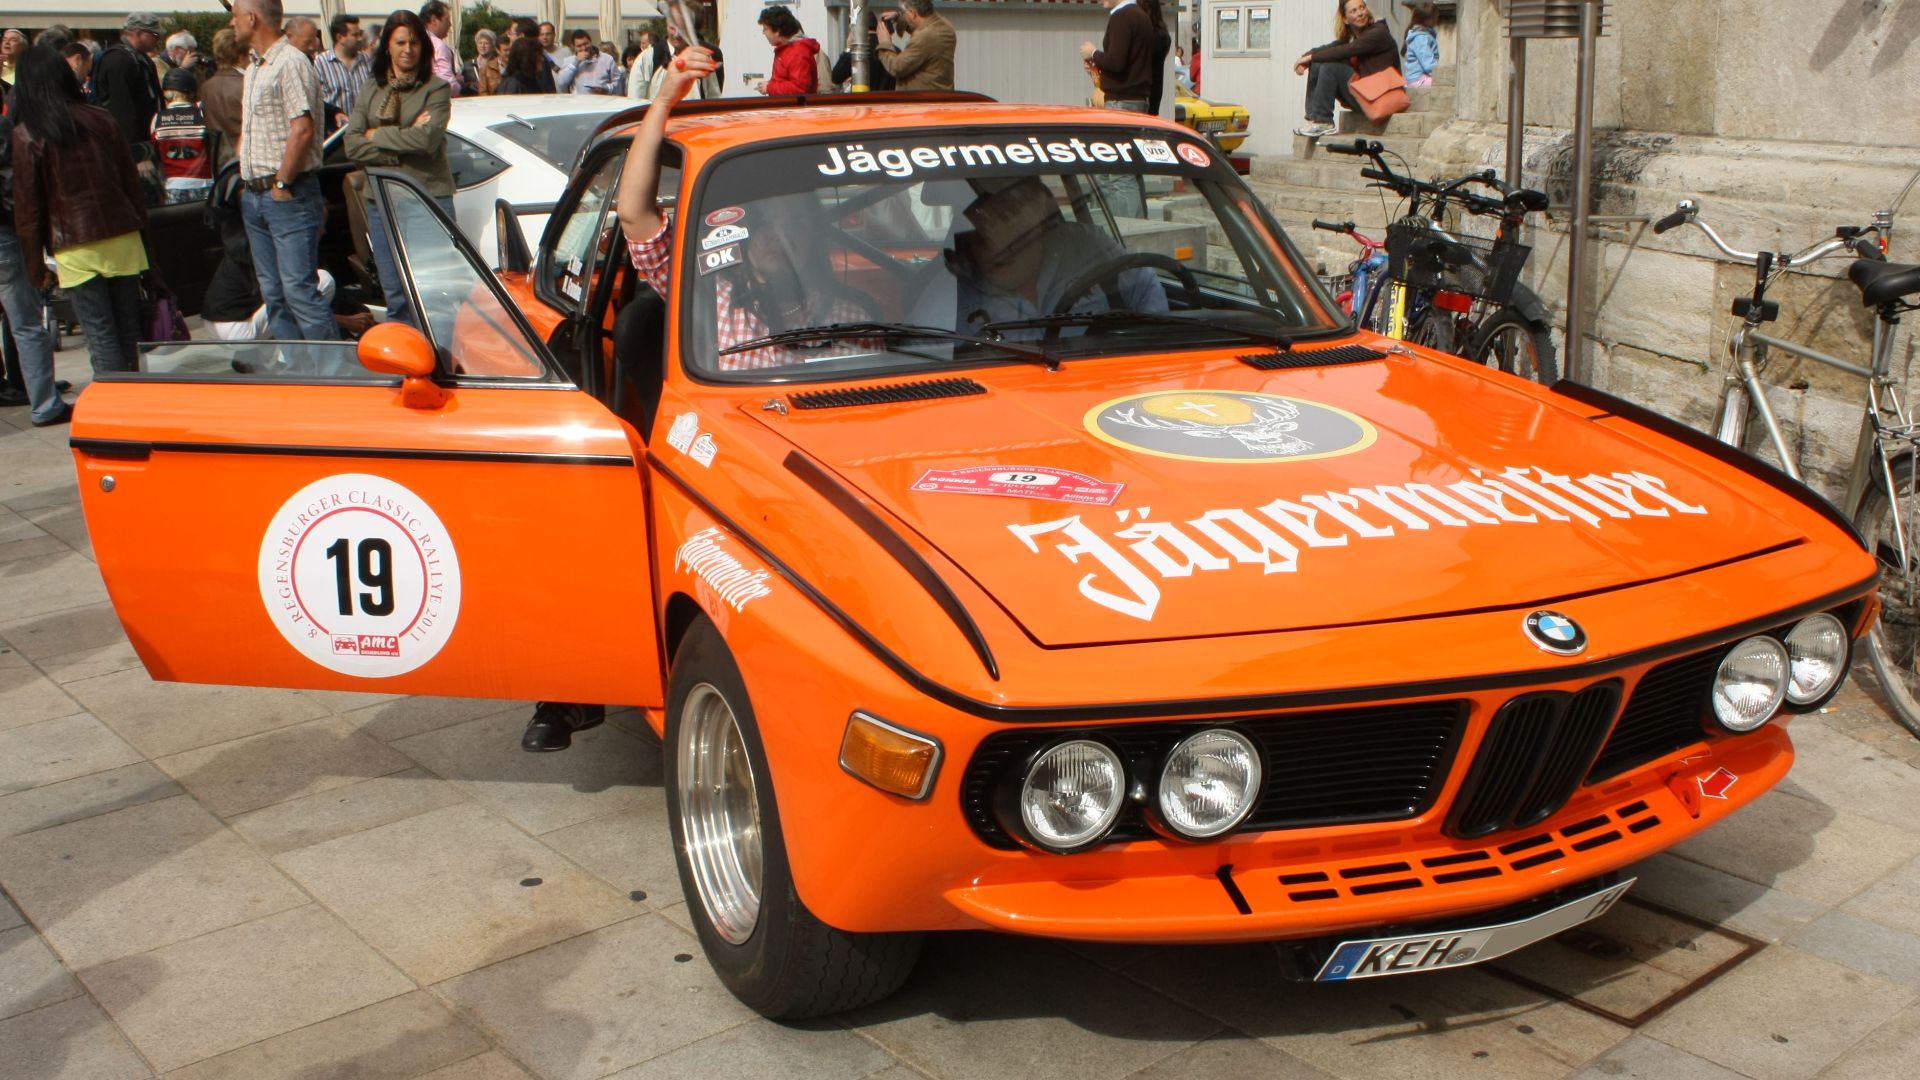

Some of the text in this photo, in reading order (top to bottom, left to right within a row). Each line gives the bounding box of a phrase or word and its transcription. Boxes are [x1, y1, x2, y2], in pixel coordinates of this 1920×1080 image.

[818, 138, 1133, 177] Jägermeister
[1146, 147, 1166, 155] VIP
[1187, 147, 1205, 162] A
[706, 247, 735, 267] OK
[1005, 474, 1038, 483] 19
[348, 490, 422, 532] CLASSIC
[276, 493, 343, 623] REGENSBURGER
[1006, 465, 1708, 621] Jägermeister
[326, 538, 395, 616] 19
[418, 533, 443, 604] RALLYE
[360, 636, 395, 649] AMC
[410, 608, 438, 642] 2011
[1331, 964, 1345, 974] D
[1355, 937, 1459, 973] KEH
